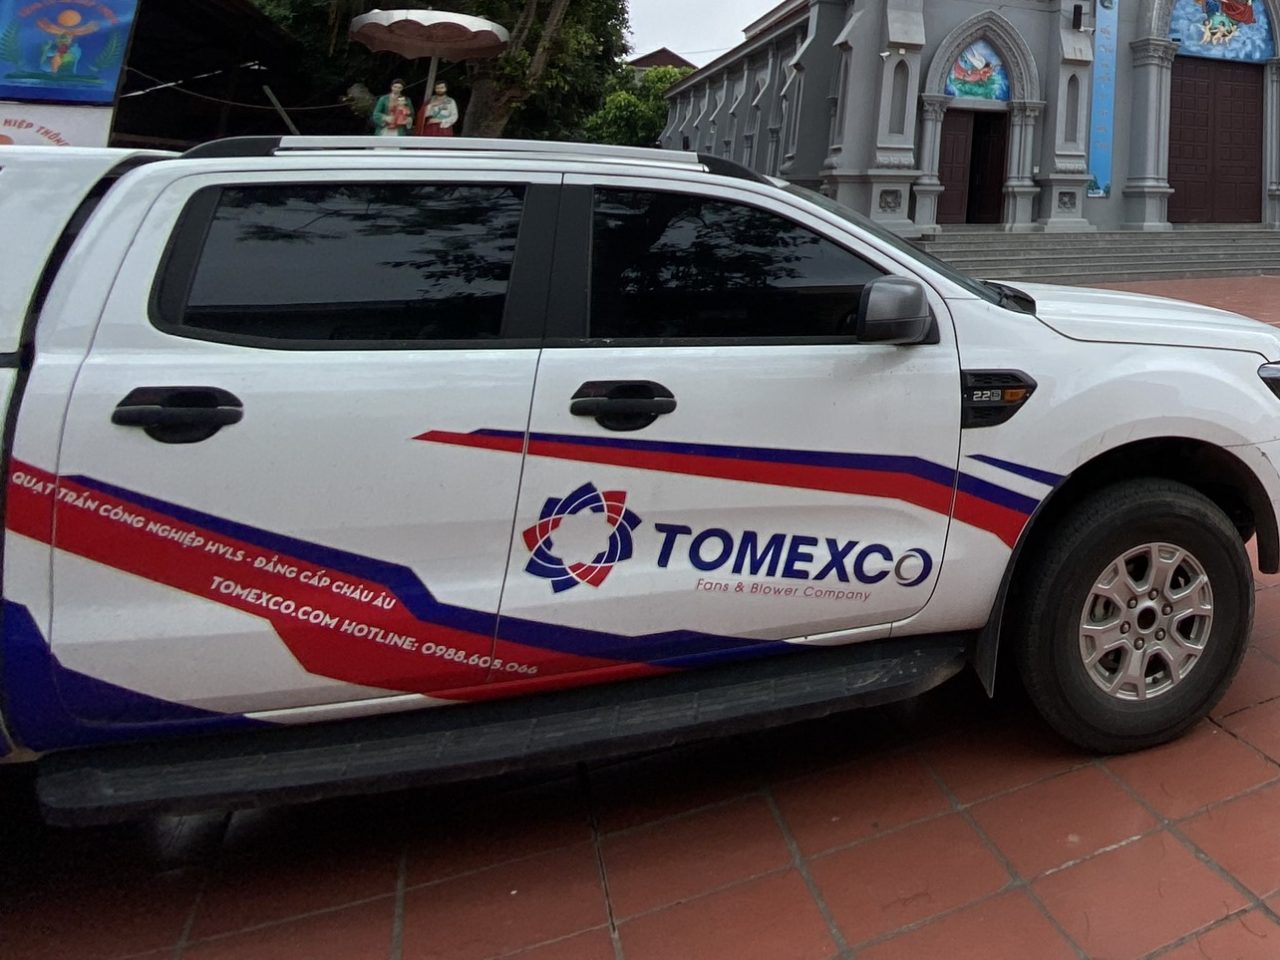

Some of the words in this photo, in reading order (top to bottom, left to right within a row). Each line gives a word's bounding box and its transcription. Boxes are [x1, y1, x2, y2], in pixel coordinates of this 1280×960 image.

[12, 471, 56, 495] QUẠT
[99, 504, 145, 528] CÔNG
[145, 521, 205, 548] NGHIỆP
[204, 541, 246, 562] HVLS
[331, 584, 374, 603] CHÂU
[372, 591, 397, 610] ÂU
[654, 522, 934, 587] TOMEXCO
[209, 575, 340, 630] TOMEXCO.COM
[339, 619, 419, 652] HOTLINE:
[421, 642, 538, 675] 0988.605.066
[696, 577, 730, 593] Fans
[734, 581, 746, 594] &
[750, 582, 799, 597] Blower
[803, 586, 872, 603] Company
